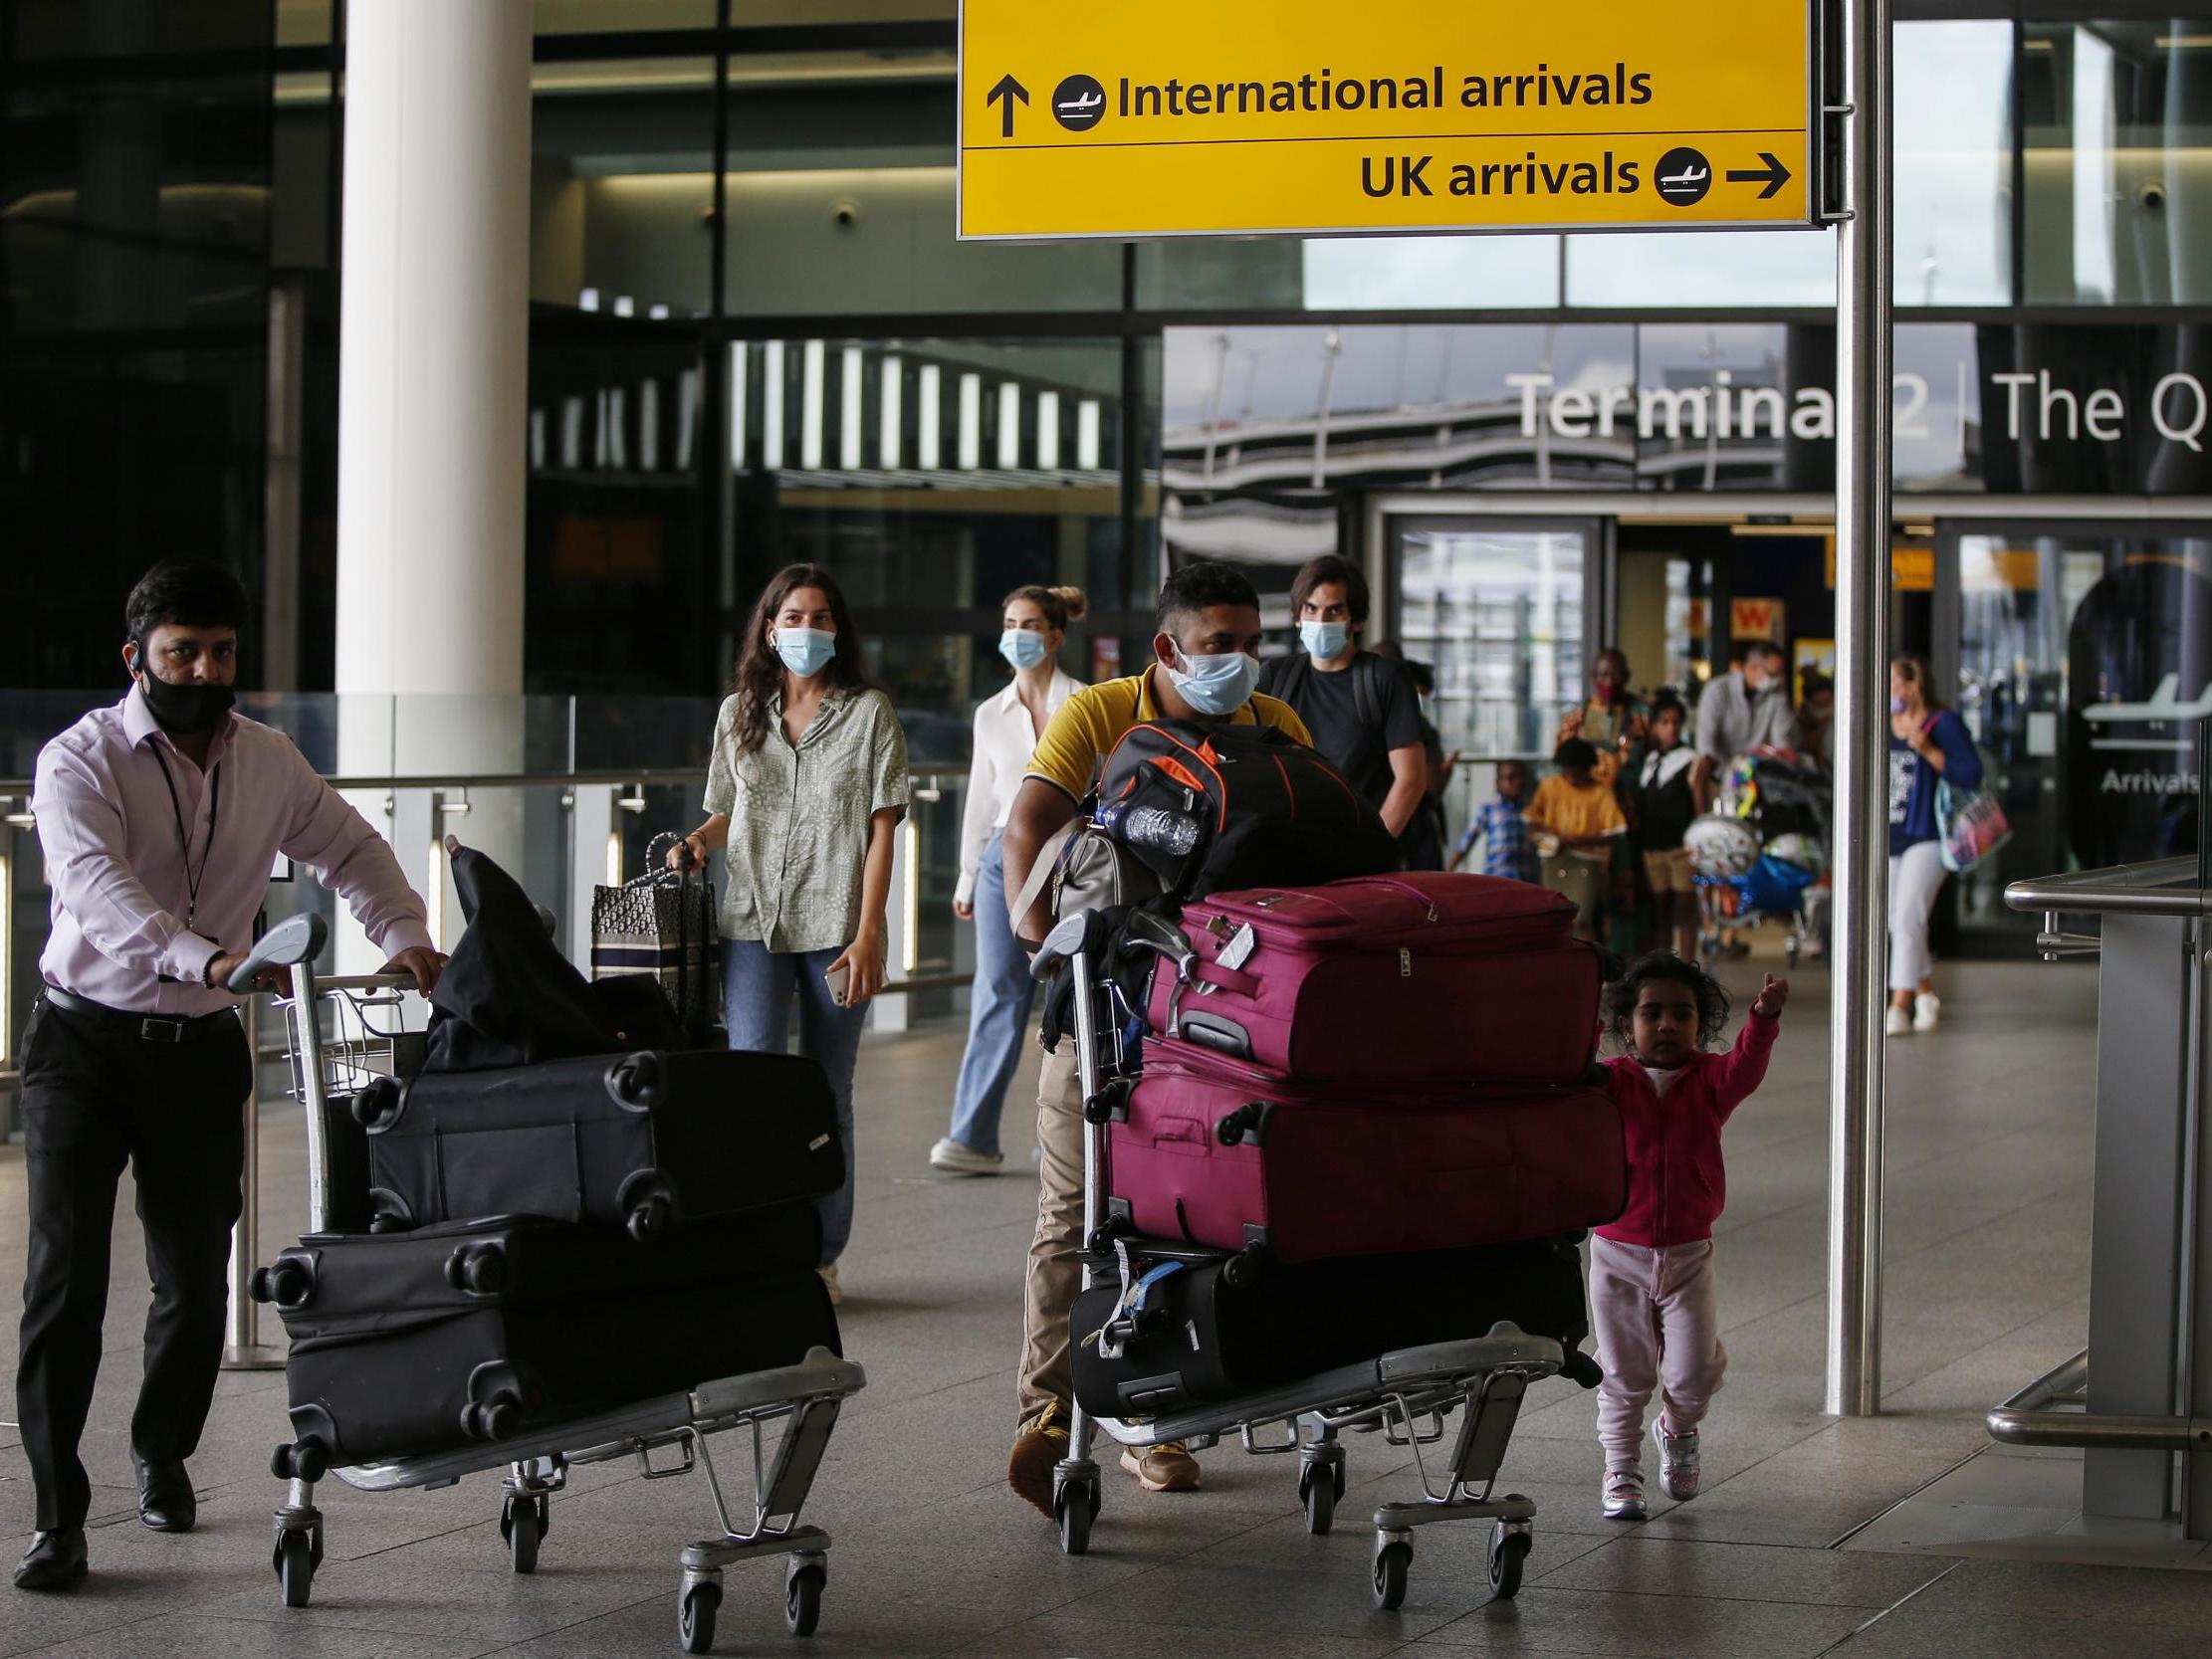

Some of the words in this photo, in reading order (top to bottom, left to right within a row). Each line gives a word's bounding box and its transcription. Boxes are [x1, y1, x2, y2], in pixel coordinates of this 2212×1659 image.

[1118, 66, 1443, 117] International
[1460, 63, 1653, 108] arrivals
[1361, 155, 1435, 198] UK
[1448, 150, 1641, 197] arrivals
[1504, 370, 1836, 438] Termina
[1892, 372, 1930, 438] 2
[1990, 368, 2125, 441] The
[2101, 768, 2200, 795] Arrivals
